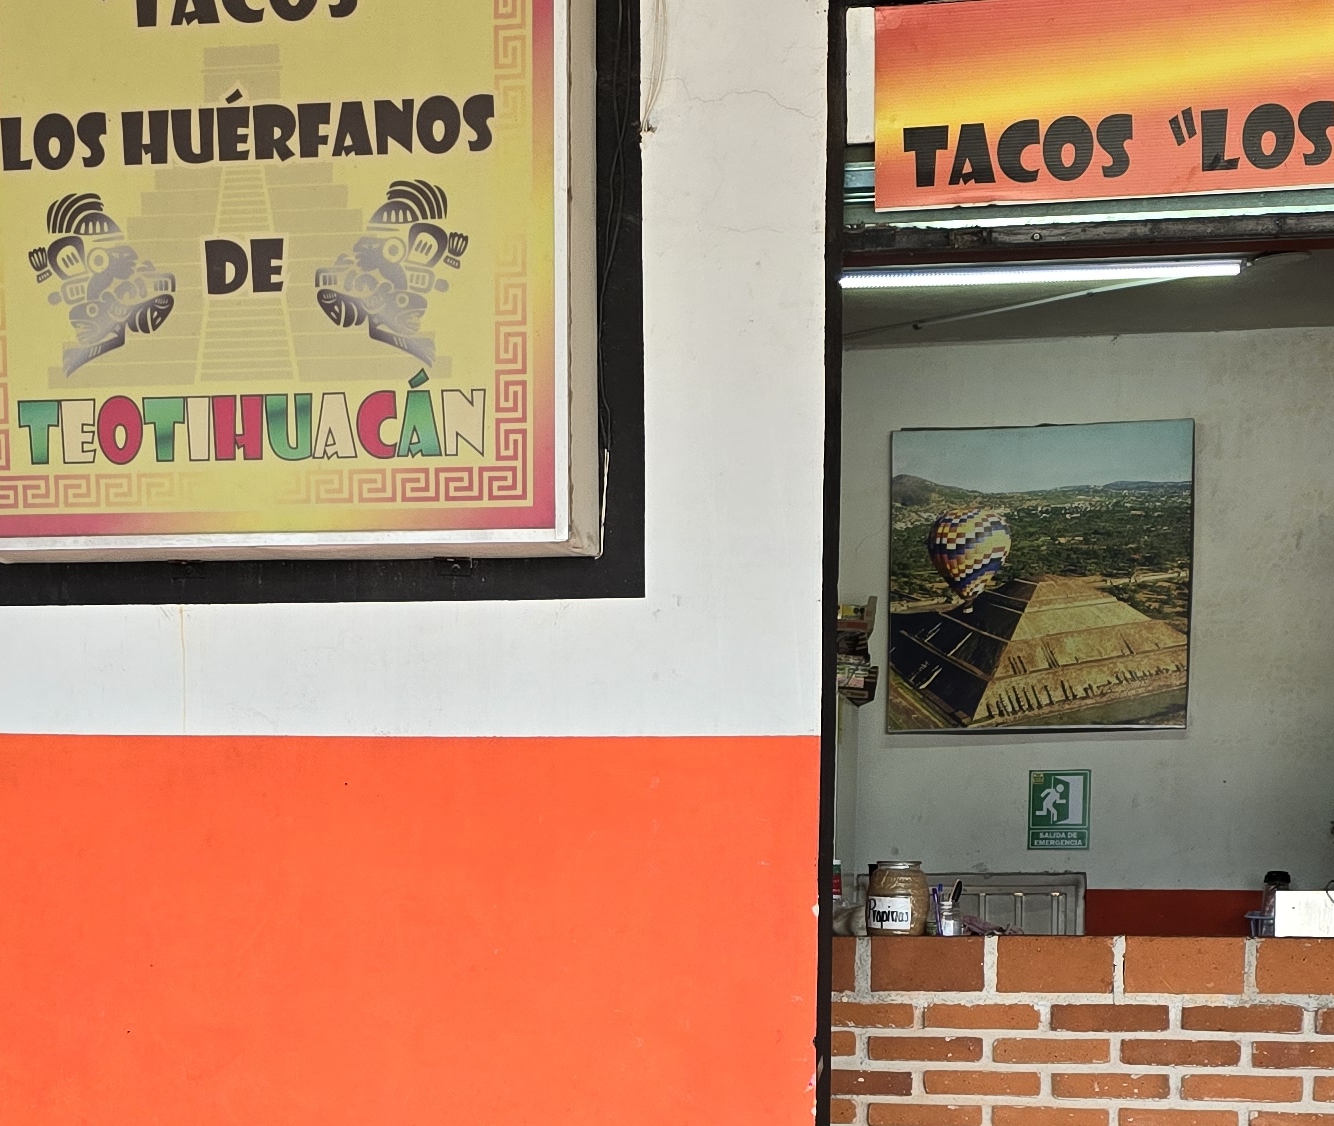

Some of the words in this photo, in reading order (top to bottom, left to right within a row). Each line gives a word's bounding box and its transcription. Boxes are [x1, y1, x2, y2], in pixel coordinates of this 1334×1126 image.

[0, 111, 107, 172] LOS
[121, 88, 496, 166] HUÉRFANOS
[902, 113, 1133, 188] TACOS
[204, 237, 285, 296] DE
[17, 368, 486, 467] TEOTIHUACÁN
[869, 898, 909, 929] Propinas
